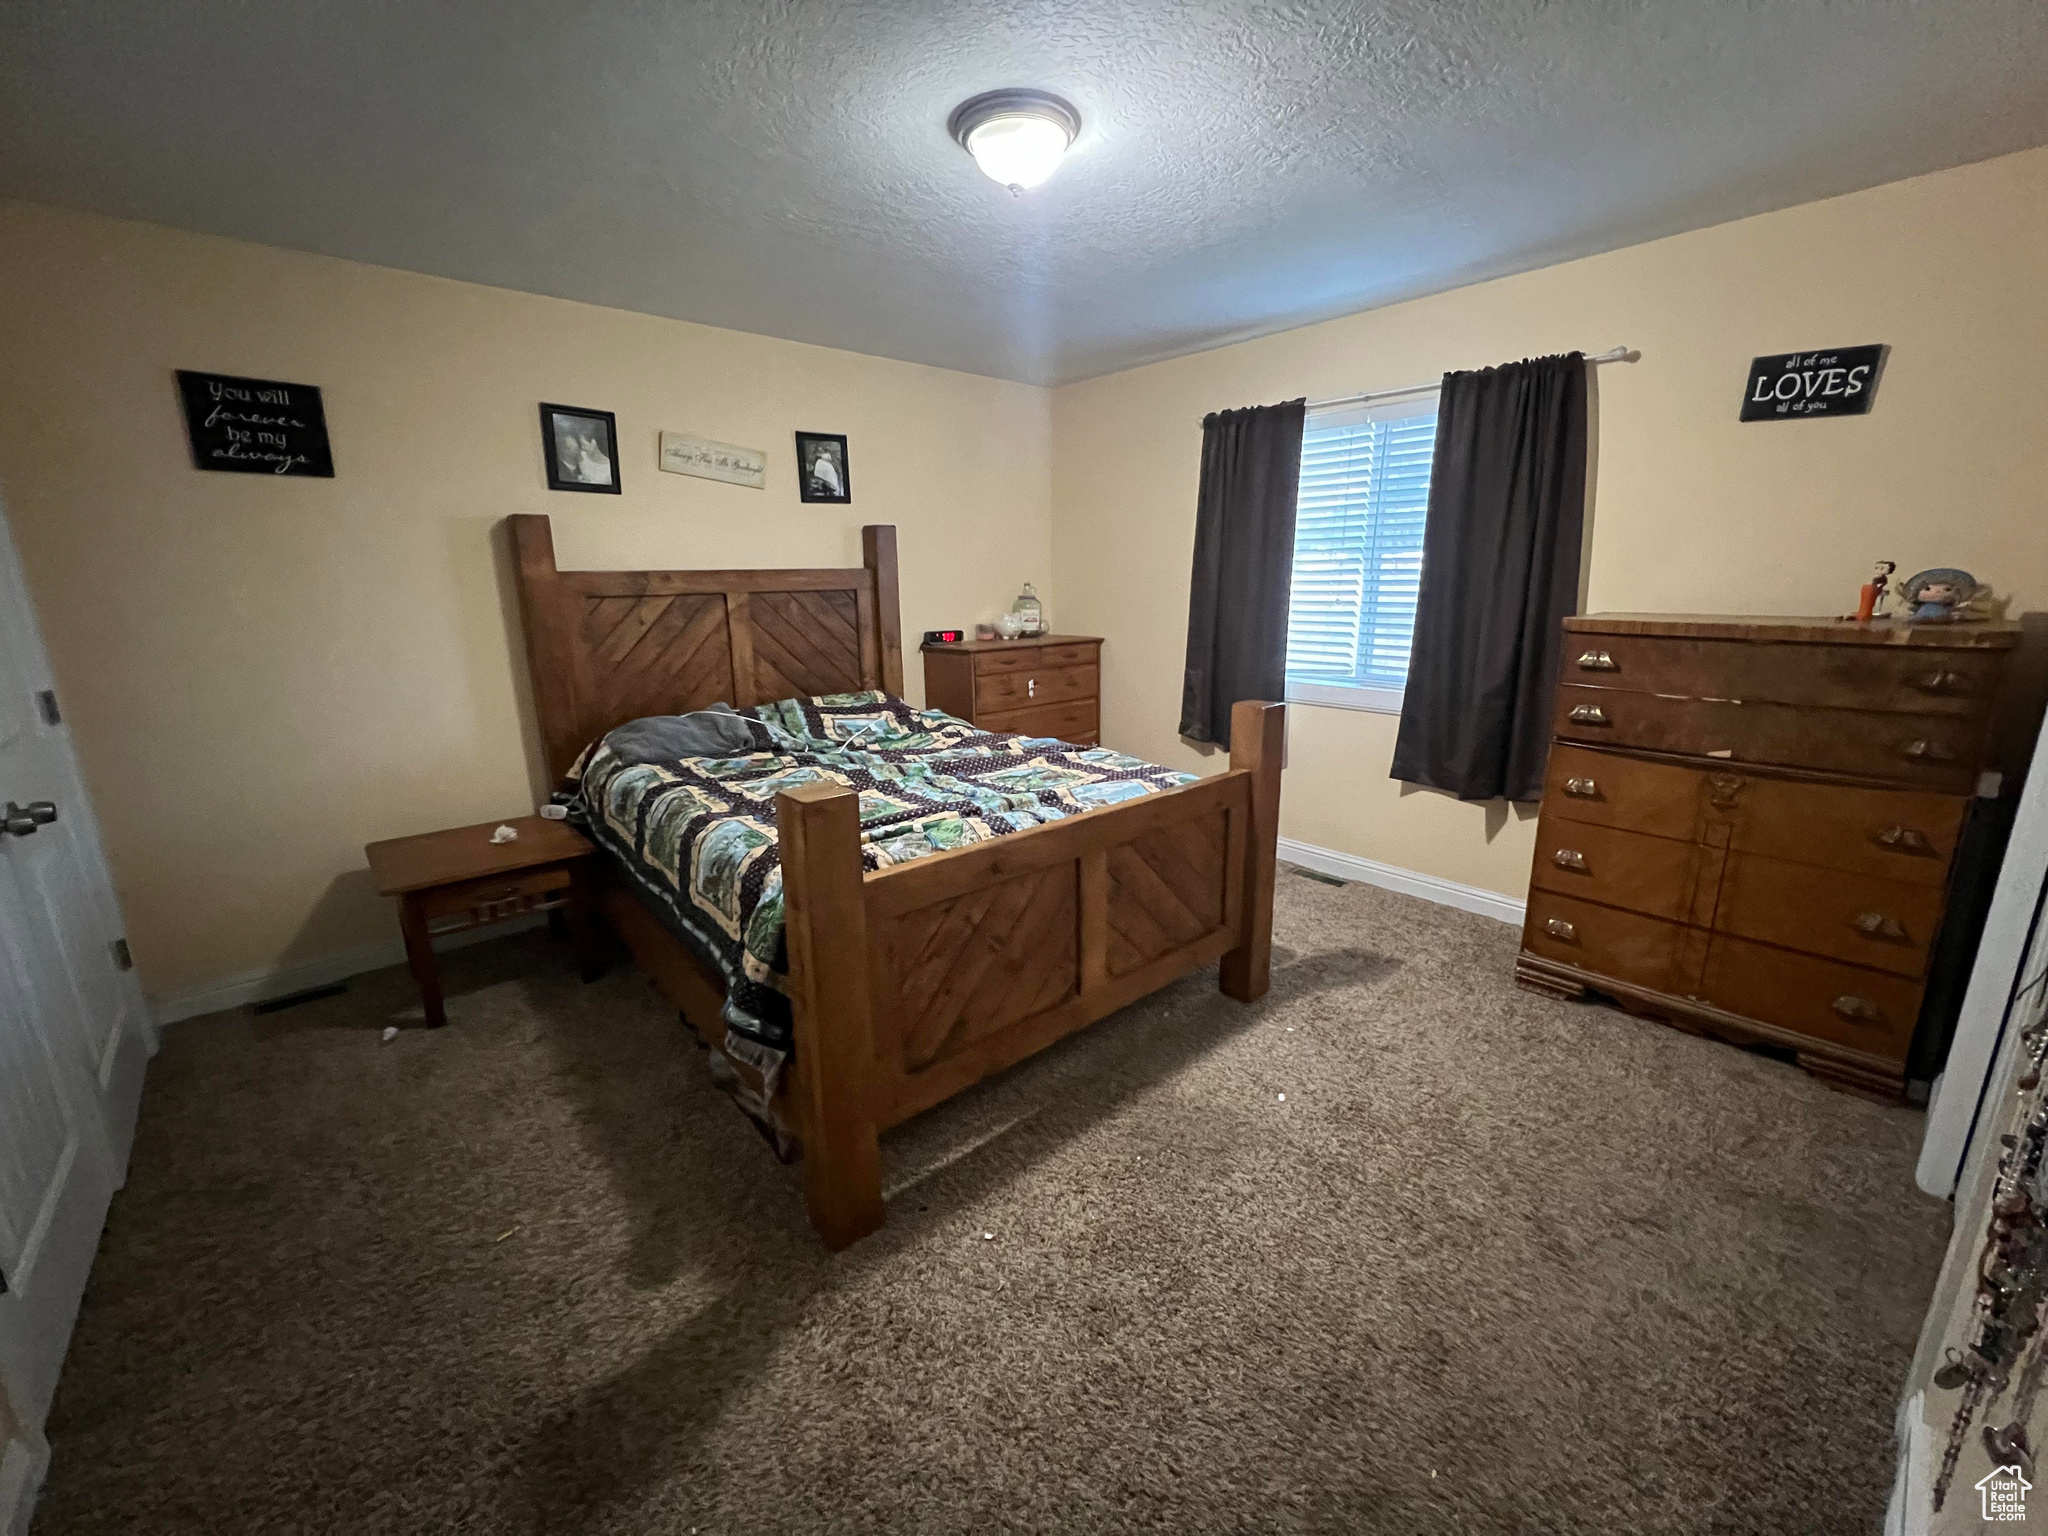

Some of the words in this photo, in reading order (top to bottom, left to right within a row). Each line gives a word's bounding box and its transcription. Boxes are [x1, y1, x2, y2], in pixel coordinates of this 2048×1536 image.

[1785, 354, 1801, 369] all
[1803, 353, 1819, 366] of
[1819, 355, 1838, 365] me
[1751, 364, 1870, 402] LOVES
[257, 389, 290, 406] will
[1775, 401, 1789, 413] all
[1792, 399, 1806, 411] of
[1804, 400, 1827, 413] you
[204, 404, 305, 428] forever
[227, 426, 251, 443] be
[258, 431, 287, 449] my
[212, 443, 310, 474] always
